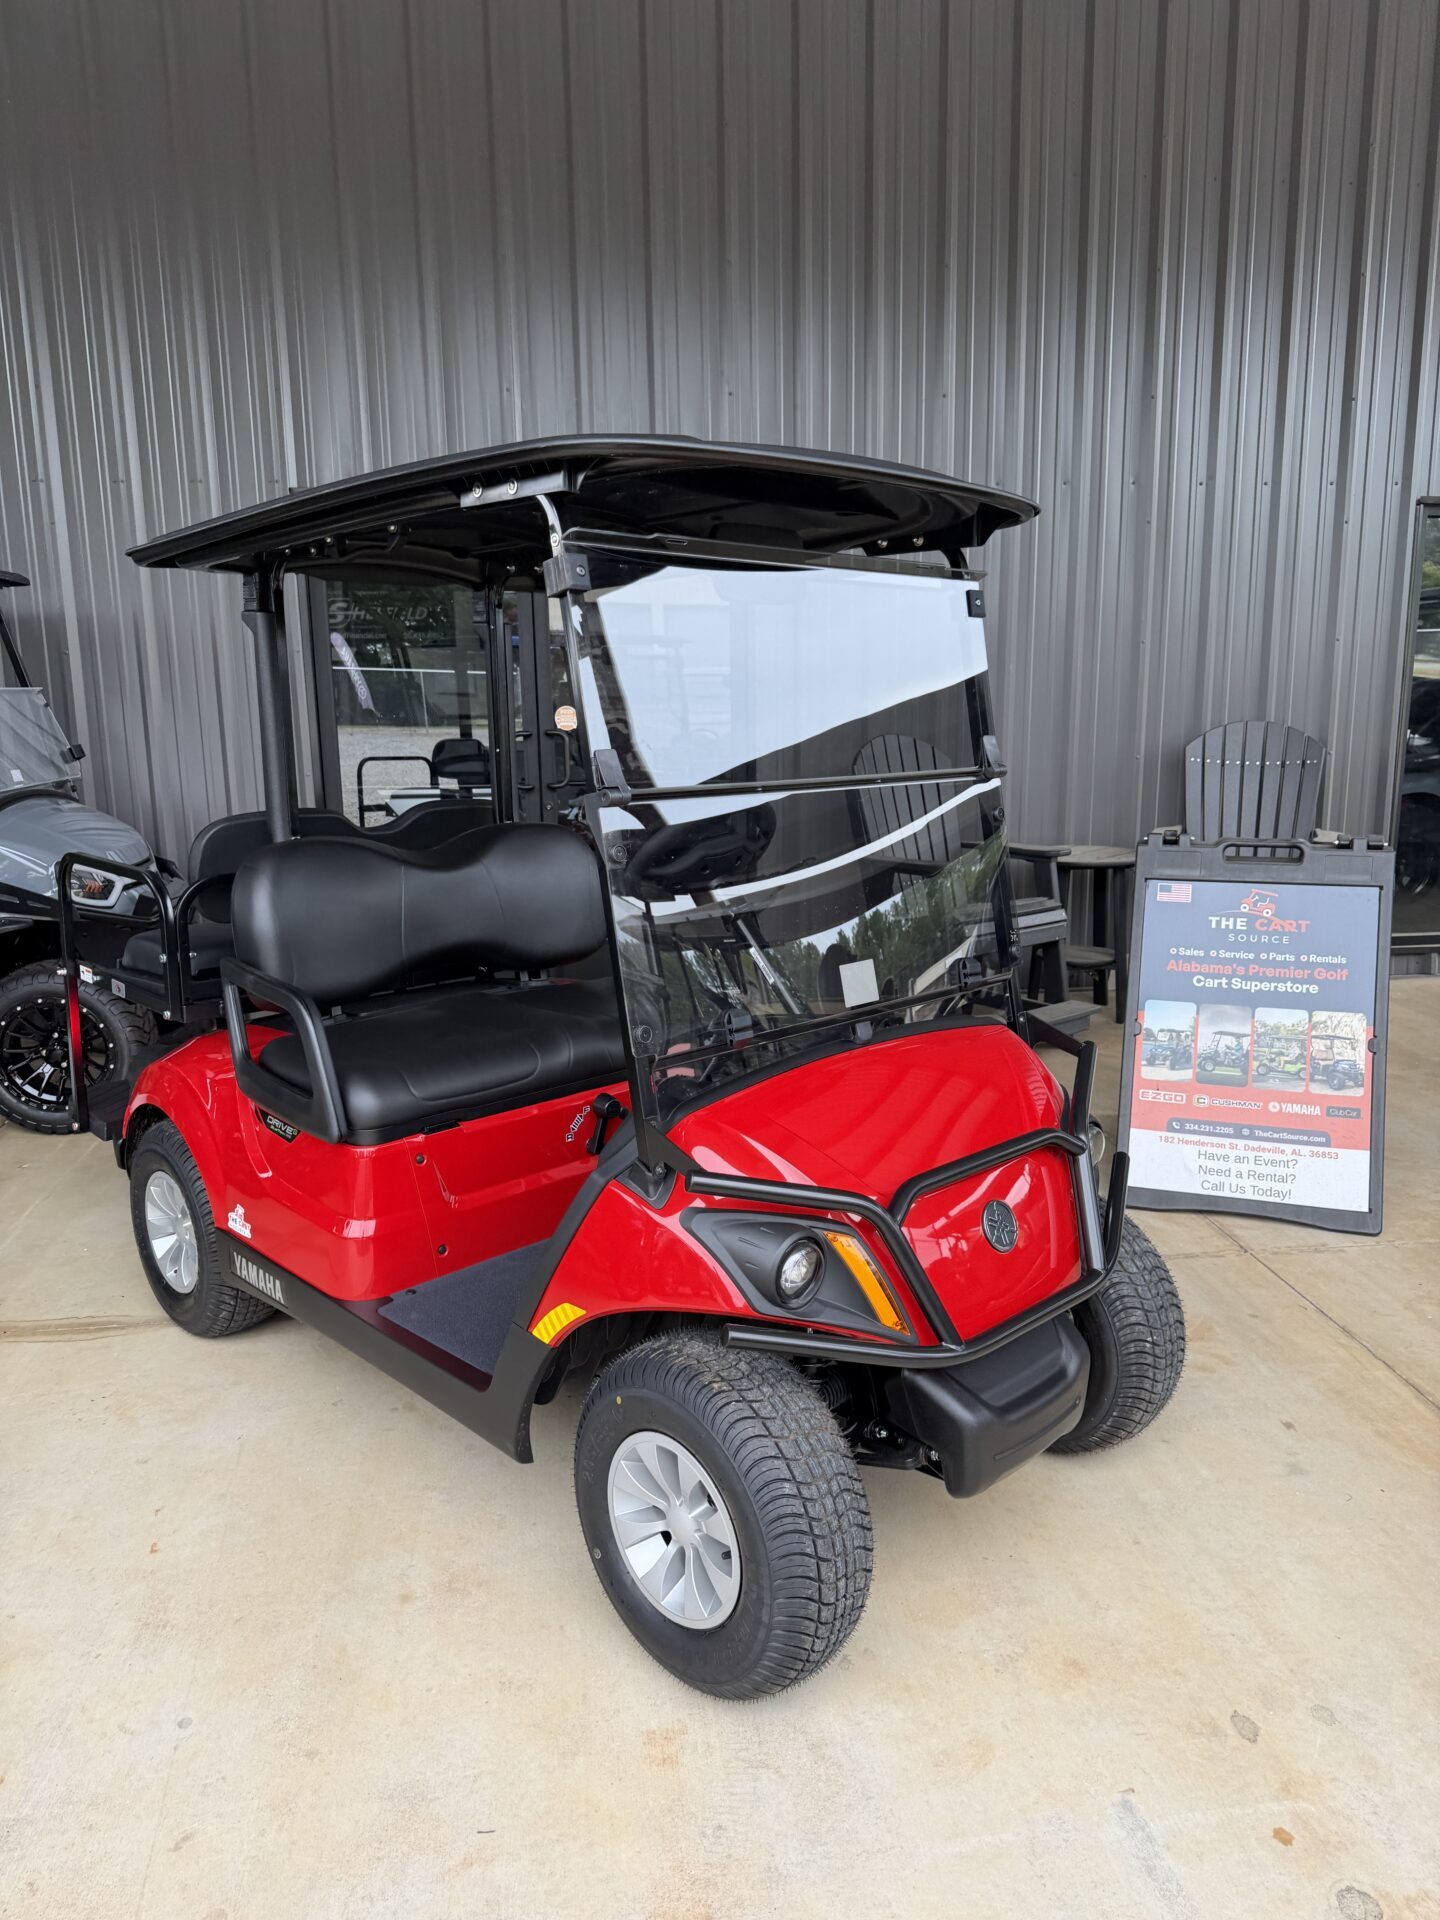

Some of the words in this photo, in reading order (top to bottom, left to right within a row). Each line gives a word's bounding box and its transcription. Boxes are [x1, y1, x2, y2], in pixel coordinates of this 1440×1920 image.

[1208, 916, 1247, 930] THE
[1255, 918, 1310, 933] CART
[1228, 933, 1290, 944] SOURCE
[1178, 947, 1204, 957] Sales
[1218, 950, 1255, 960] Service
[1269, 952, 1295, 962] Parts
[1309, 954, 1347, 964] Rentals
[1167, 959, 1245, 976] Alabama's
[1248, 964, 1311, 979] Premier
[1314, 967, 1349, 981] Golf
[1192, 975, 1228, 988] Cart
[1231, 978, 1319, 993] Superstore
[1211, 1099, 1262, 1109] CUSHMAN
[1280, 1102, 1321, 1116] YAMAHA
[1184, 1123, 1234, 1134] 334.231.2205
[1254, 1130, 1326, 1143] TheCartSource.com
[1159, 1135, 1175, 1144] 182
[1177, 1137, 1226, 1149] Henderson
[1228, 1142, 1240, 1151] St.
[1243, 1143, 1288, 1156] Dadeville,
[1290, 1148, 1306, 1157] AL.
[1309, 1150, 1339, 1160] 36853
[1197, 1149, 1230, 1163] Have
[1233, 1154, 1250, 1165] an
[1253, 1155, 1298, 1169] Event?
[1198, 1164, 1231, 1178] Need
[1235, 1170, 1243, 1179] a
[1247, 1169, 1297, 1184] Rental?
[1201, 1180, 1225, 1192] Call
[1229, 1182, 1246, 1194] Us
[1250, 1185, 1292, 1201] Today!
[233, 1252, 285, 1304] YAMAHA
